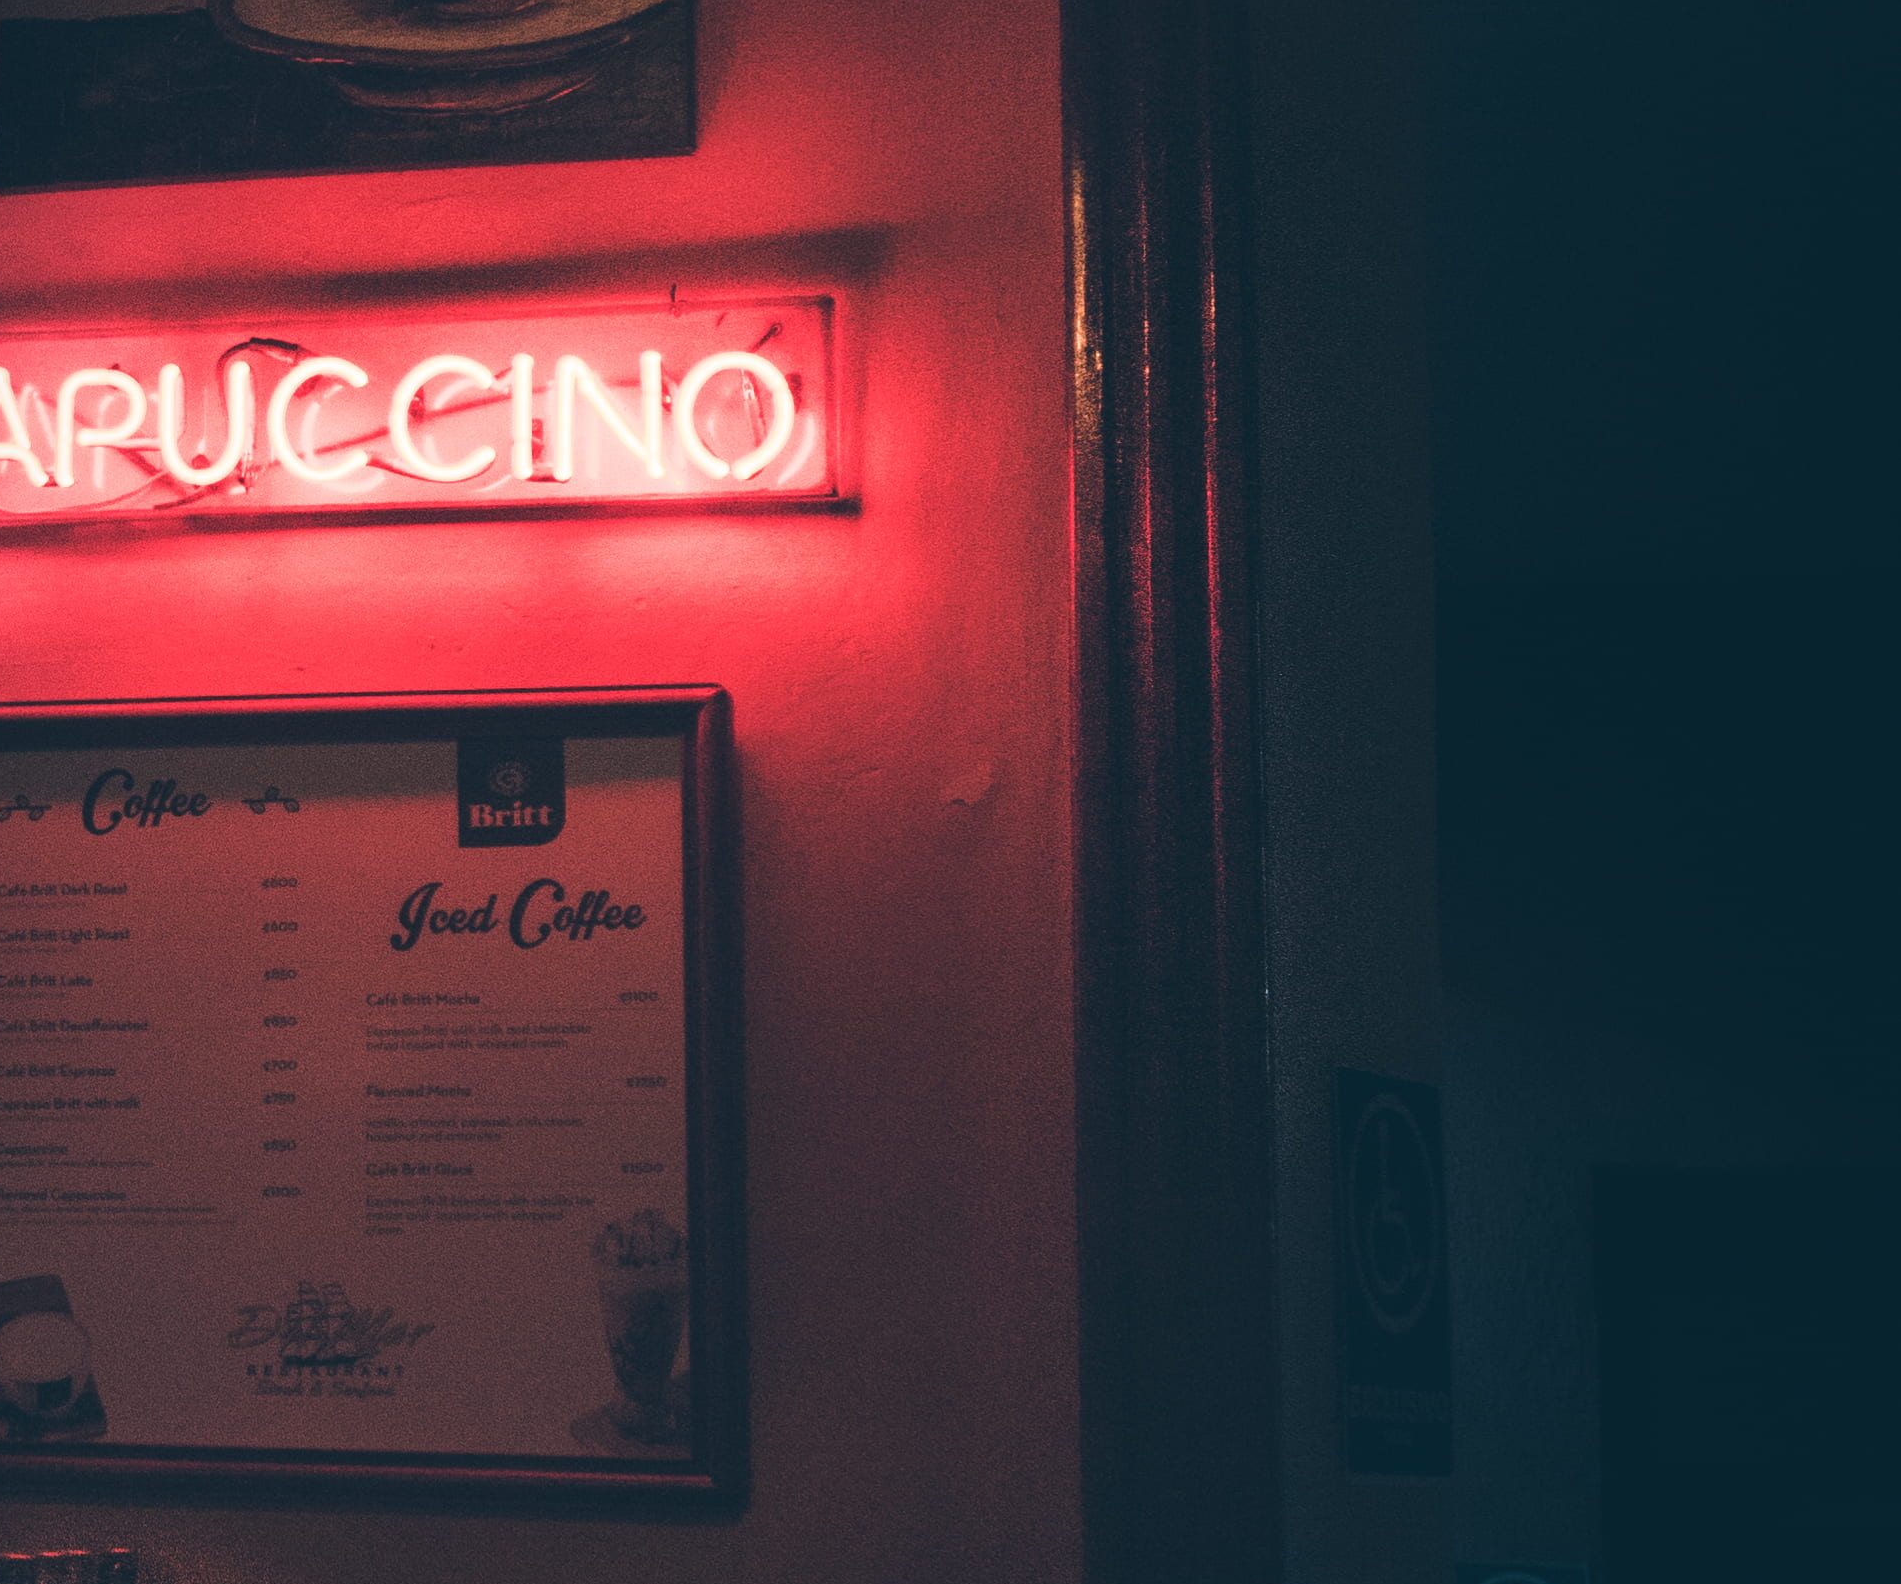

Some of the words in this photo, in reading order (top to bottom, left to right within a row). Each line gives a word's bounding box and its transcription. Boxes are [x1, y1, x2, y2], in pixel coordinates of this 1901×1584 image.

[81, 767, 214, 836] Coffee
[468, 800, 554, 829] Britt
[390, 882, 498, 952] Iced
[508, 878, 647, 949] Coffee
